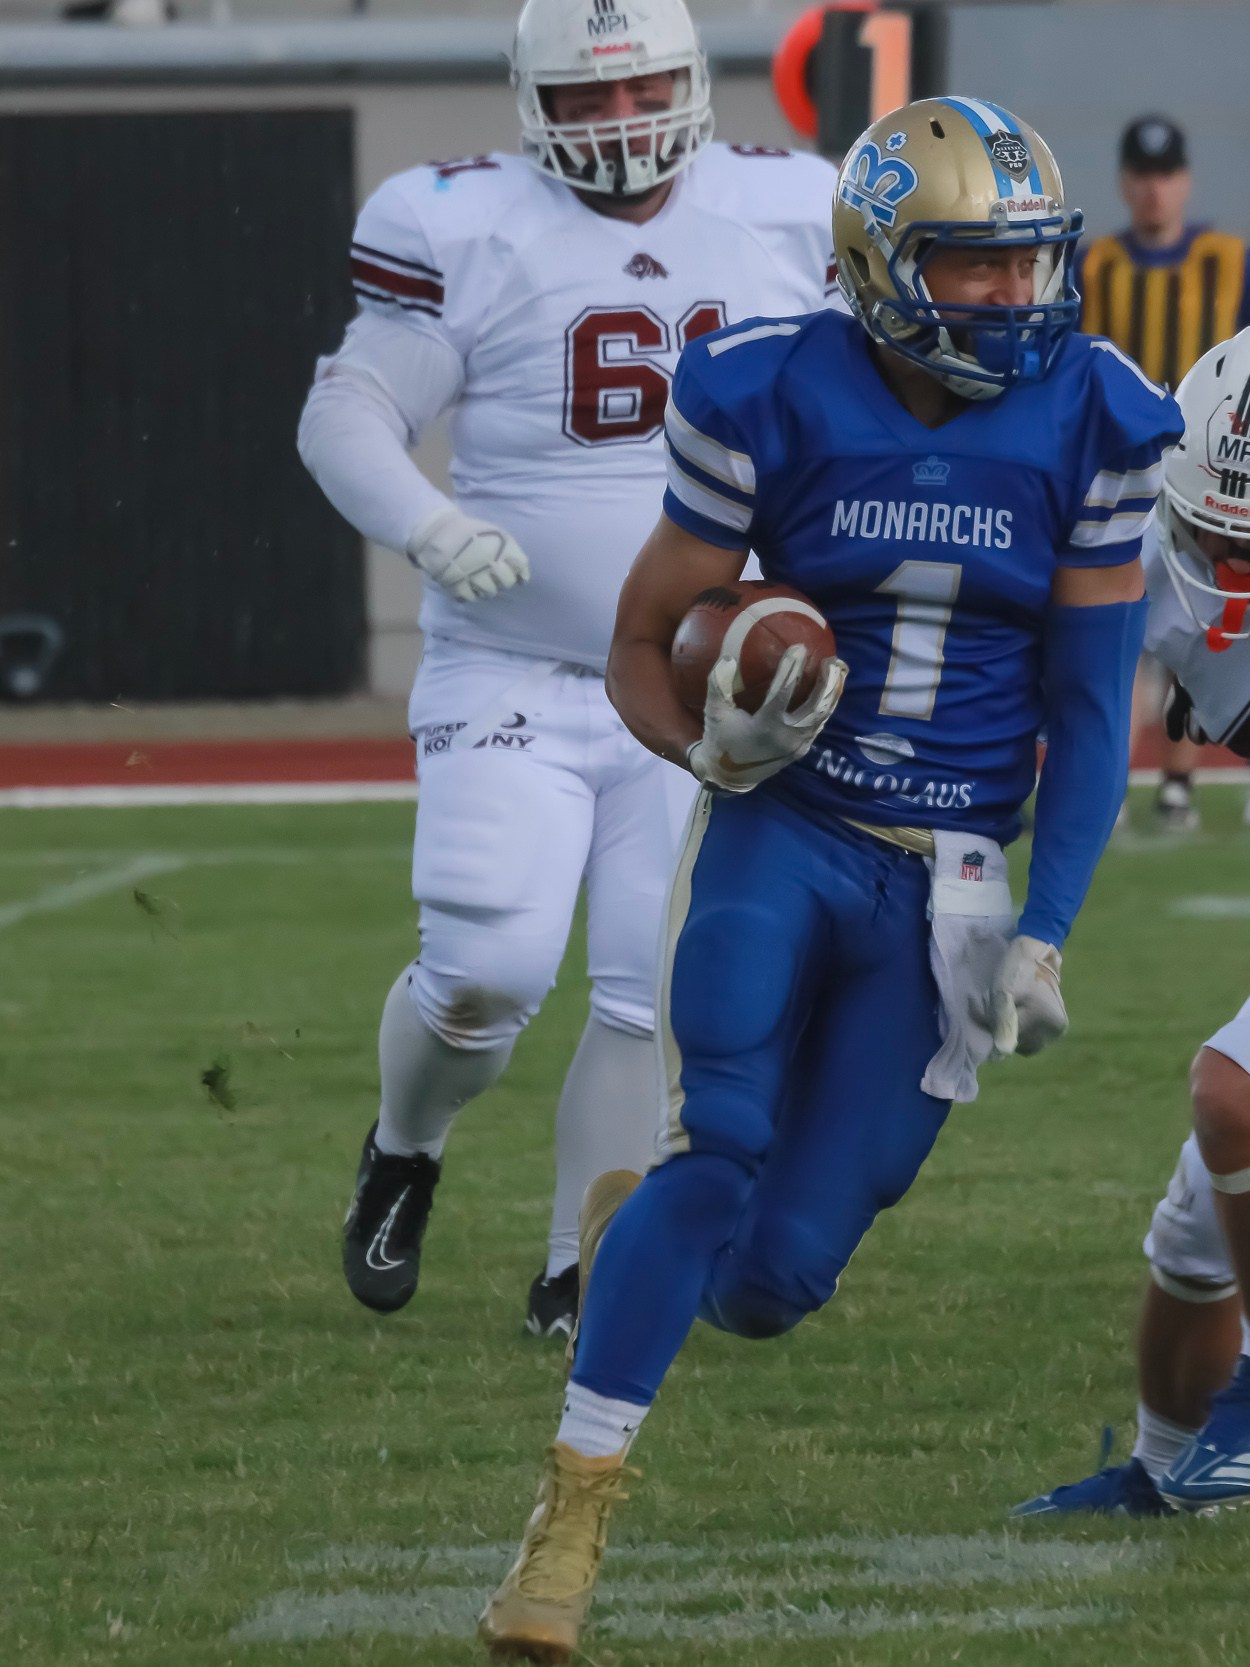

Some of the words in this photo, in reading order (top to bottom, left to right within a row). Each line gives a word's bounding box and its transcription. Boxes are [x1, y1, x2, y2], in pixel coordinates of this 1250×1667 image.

[587, 14, 628, 36] MPI
[857, 10, 912, 127] 1
[1007, 198, 1046, 212] Riddell
[830, 499, 1013, 549] MONARCHS
[874, 559, 963, 722] 1
[815, 750, 977, 808] NICOLAUS
